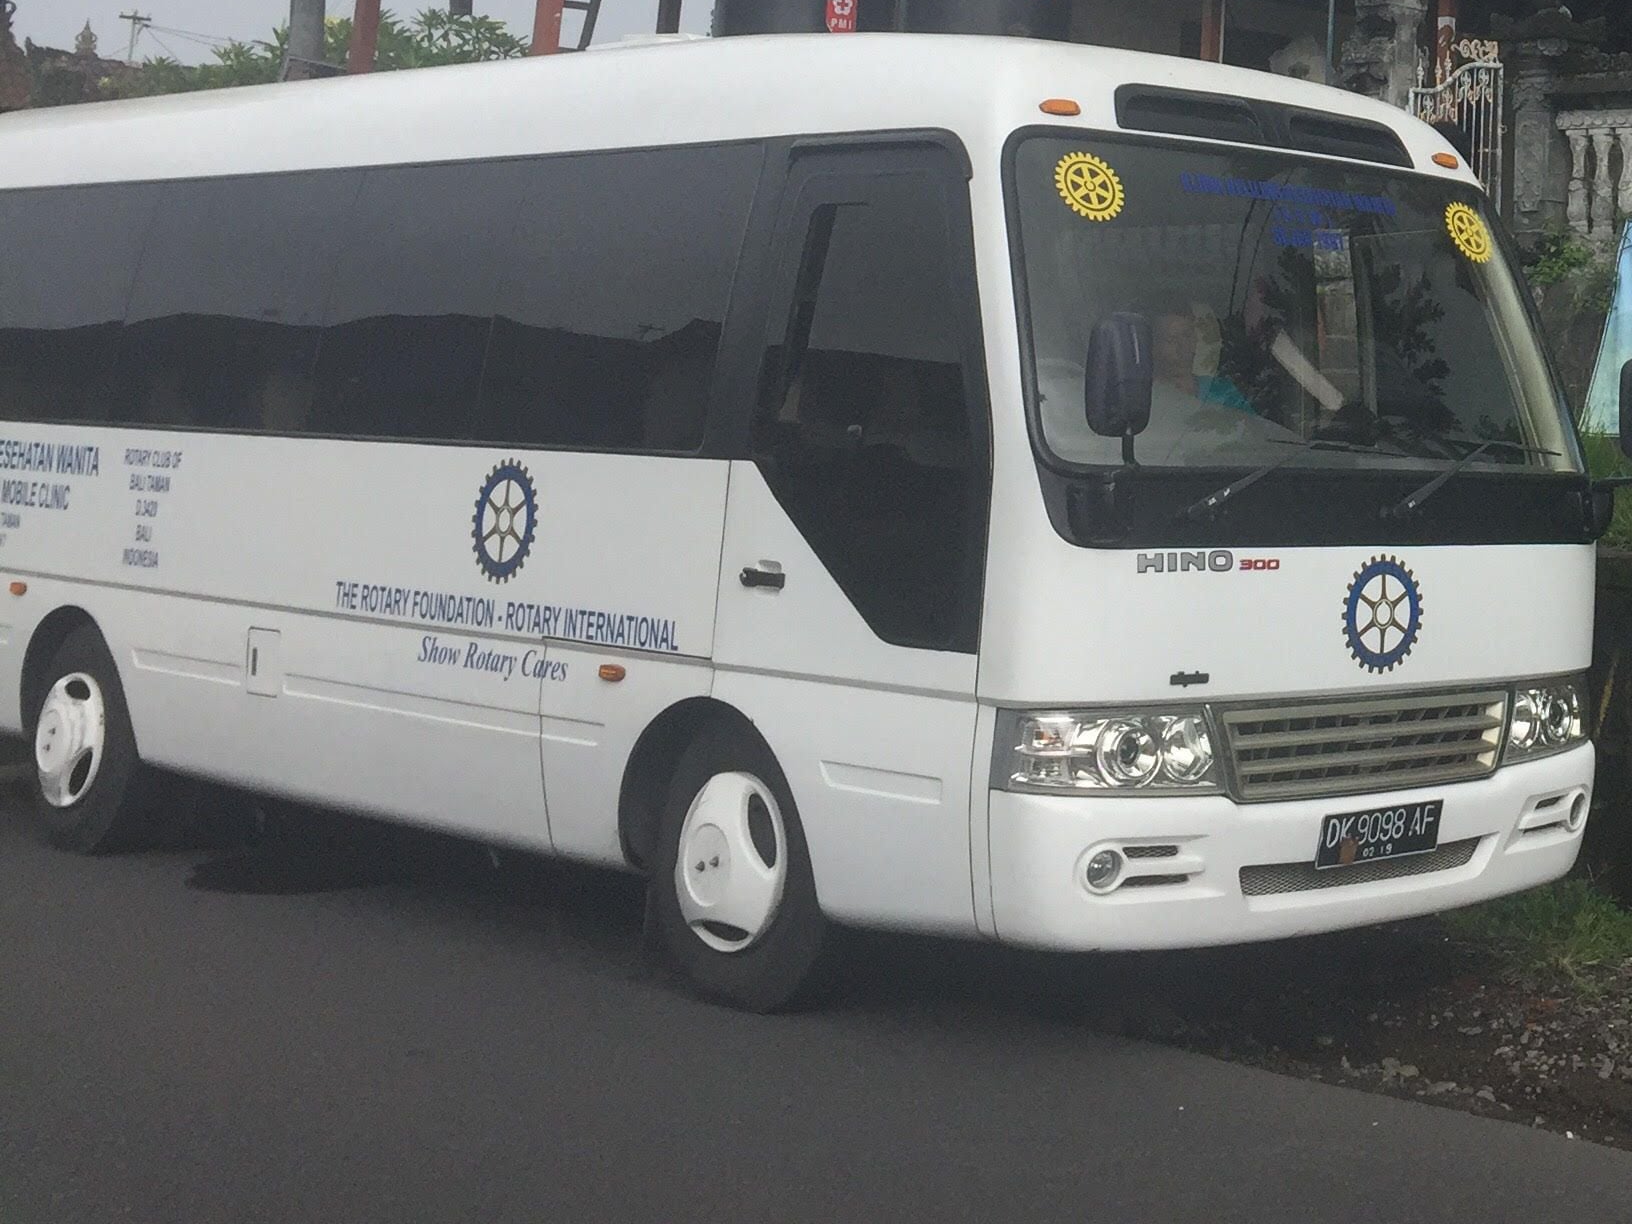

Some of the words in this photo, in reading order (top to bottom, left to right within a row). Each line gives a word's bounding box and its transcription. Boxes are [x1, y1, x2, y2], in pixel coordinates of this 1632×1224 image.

[831, 18, 851, 30] PMI
[56, 444, 100, 476] WANITA
[2, 480, 37, 507] MOBILE
[38, 483, 70, 510] CLINIC
[1137, 550, 1233, 573] HINO
[1239, 559, 1280, 571] 300
[335, 581, 359, 610] THE
[360, 584, 411, 617] ROTARY
[411, 590, 494, 628] FOUNDATION
[504, 602, 561, 636] ROTARY
[563, 607, 679, 652] INTERNATIONAL
[418, 635, 461, 664] Show
[463, 641, 517, 682] Rotary
[520, 649, 569, 682] Cares
[1326, 816, 1355, 848] DK
[1358, 808, 1407, 845] 9098
[1408, 805, 1435, 836] AF
